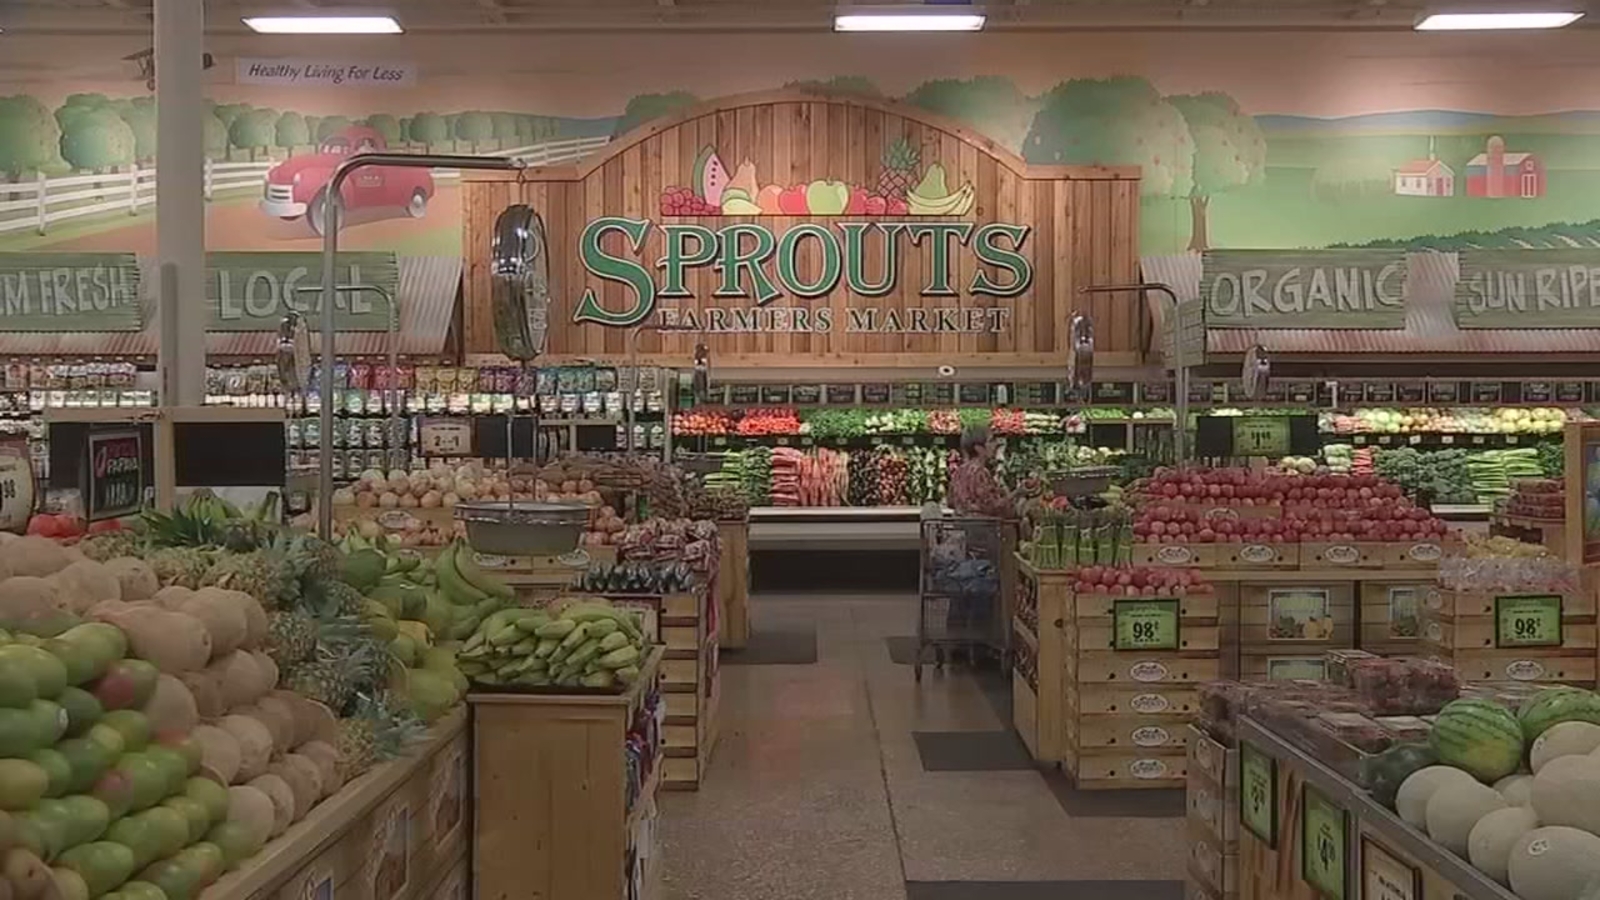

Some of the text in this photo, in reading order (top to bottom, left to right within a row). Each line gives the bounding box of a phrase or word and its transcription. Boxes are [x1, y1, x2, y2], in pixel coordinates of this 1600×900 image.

[250, 64, 405, 84] Healthy Living For Less
[39, 266, 128, 315] FRESH
[574, 217, 1034, 326] SPROUTS
[1210, 264, 1402, 318] ORGANIC
[1466, 272, 1526, 316] SUN
[657, 307, 1010, 333] FARMERS MARKET
